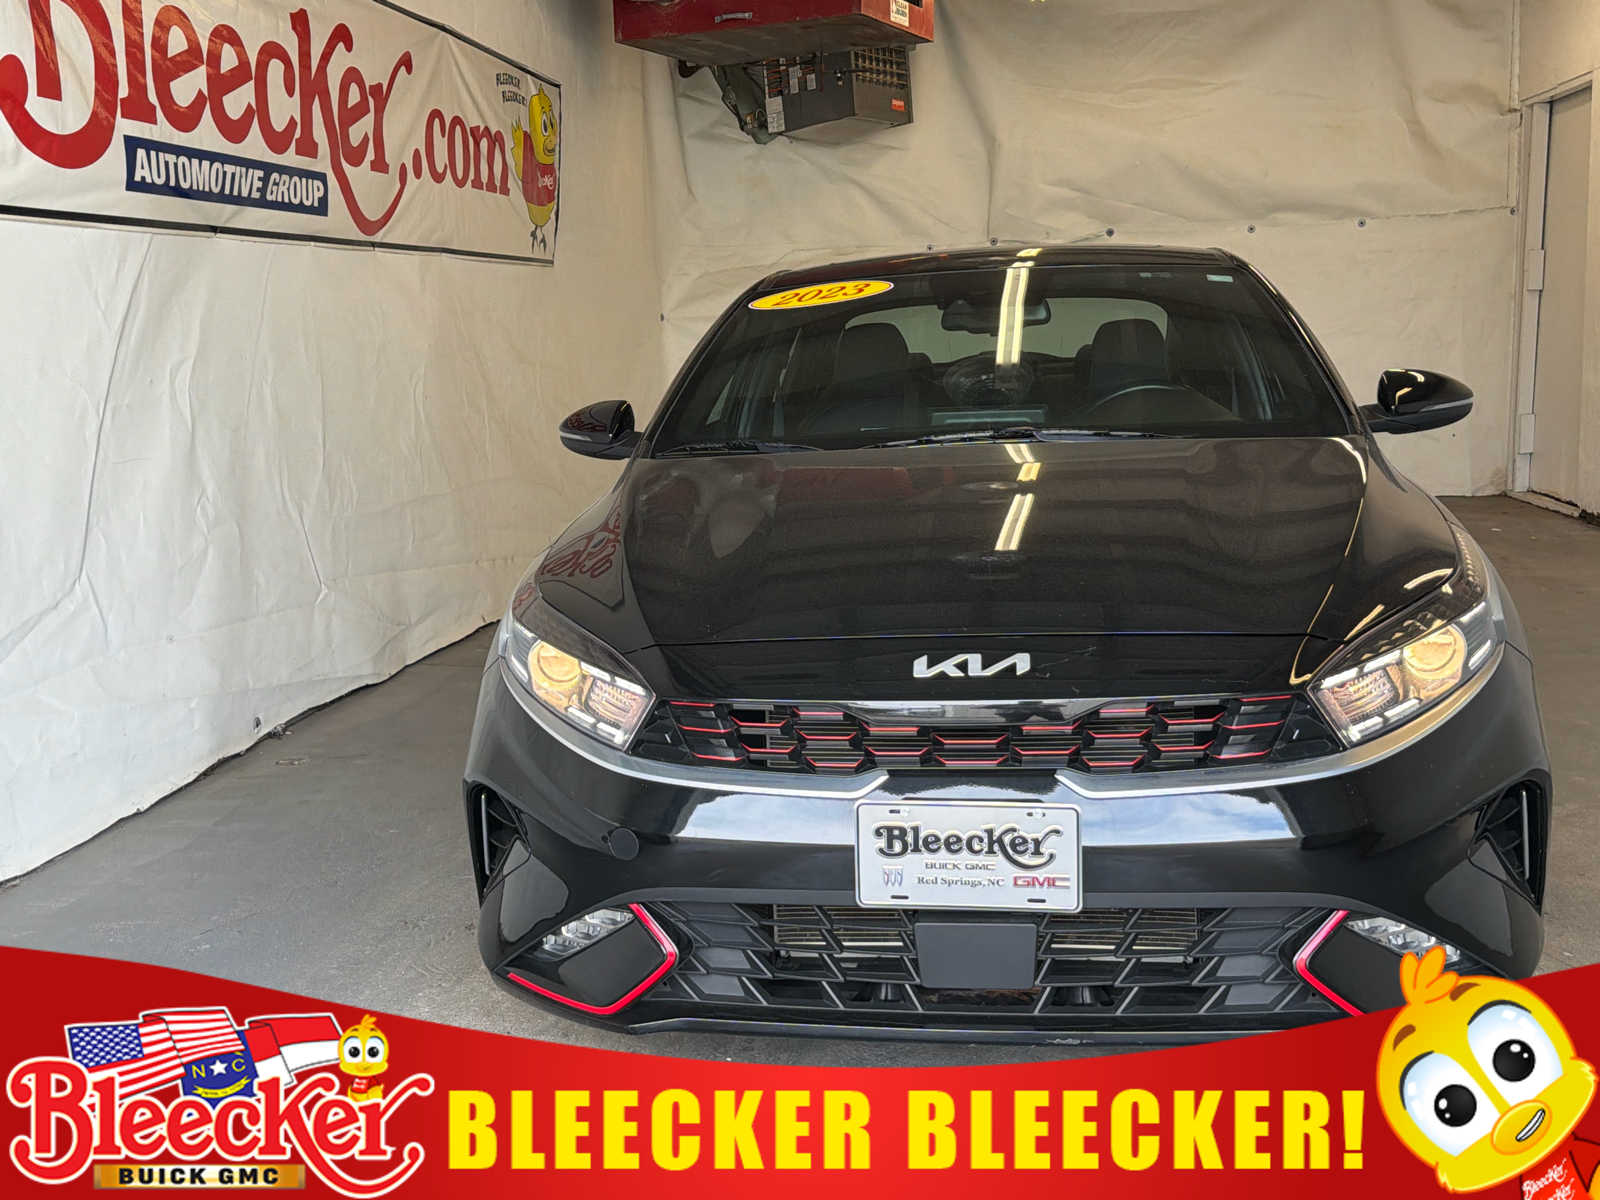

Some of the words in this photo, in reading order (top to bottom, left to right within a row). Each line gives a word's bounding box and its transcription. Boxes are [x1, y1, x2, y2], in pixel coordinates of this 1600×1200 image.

[134, 148, 263, 199] AUTOMOTIVE
[265, 171, 325, 208] GROUP
[770, 283, 872, 306] 2023
[924, 862, 961, 871] BUICK
[965, 863, 996, 871] GMC
[917, 876, 938, 885] Red
[1013, 875, 1070, 889] GMC
